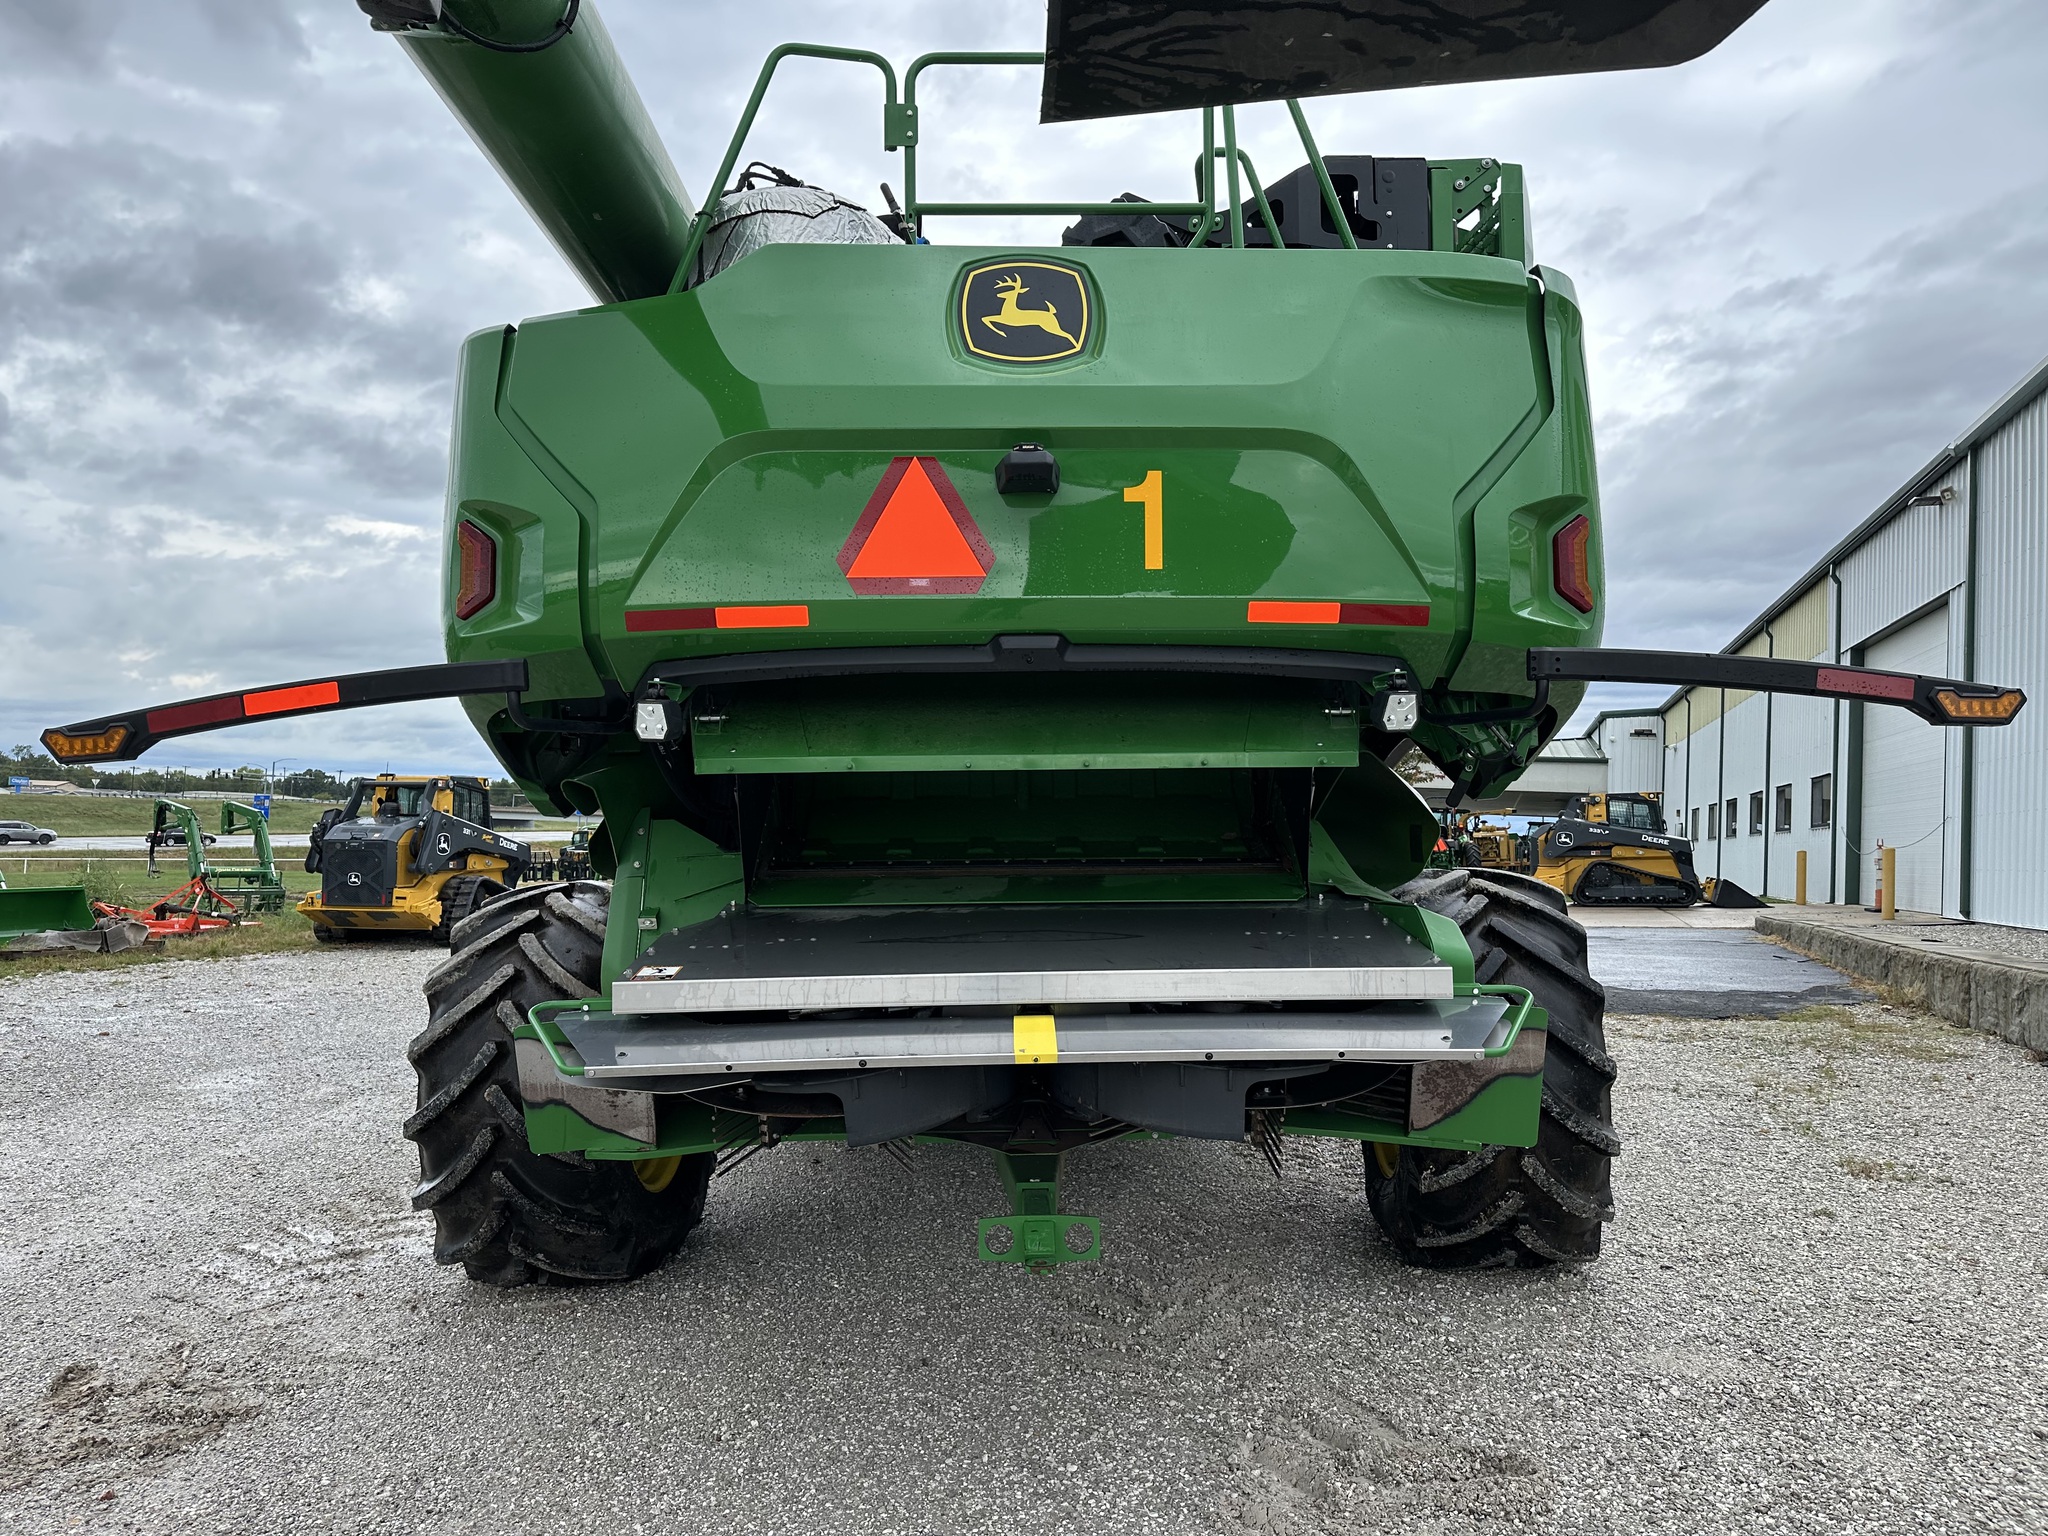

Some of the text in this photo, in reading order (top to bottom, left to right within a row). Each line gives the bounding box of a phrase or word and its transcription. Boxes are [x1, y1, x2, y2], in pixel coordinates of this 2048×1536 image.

[1123, 470, 1163, 570] 1
[499, 837, 518, 851] DEERE
[1641, 834, 1670, 845] DEERE
